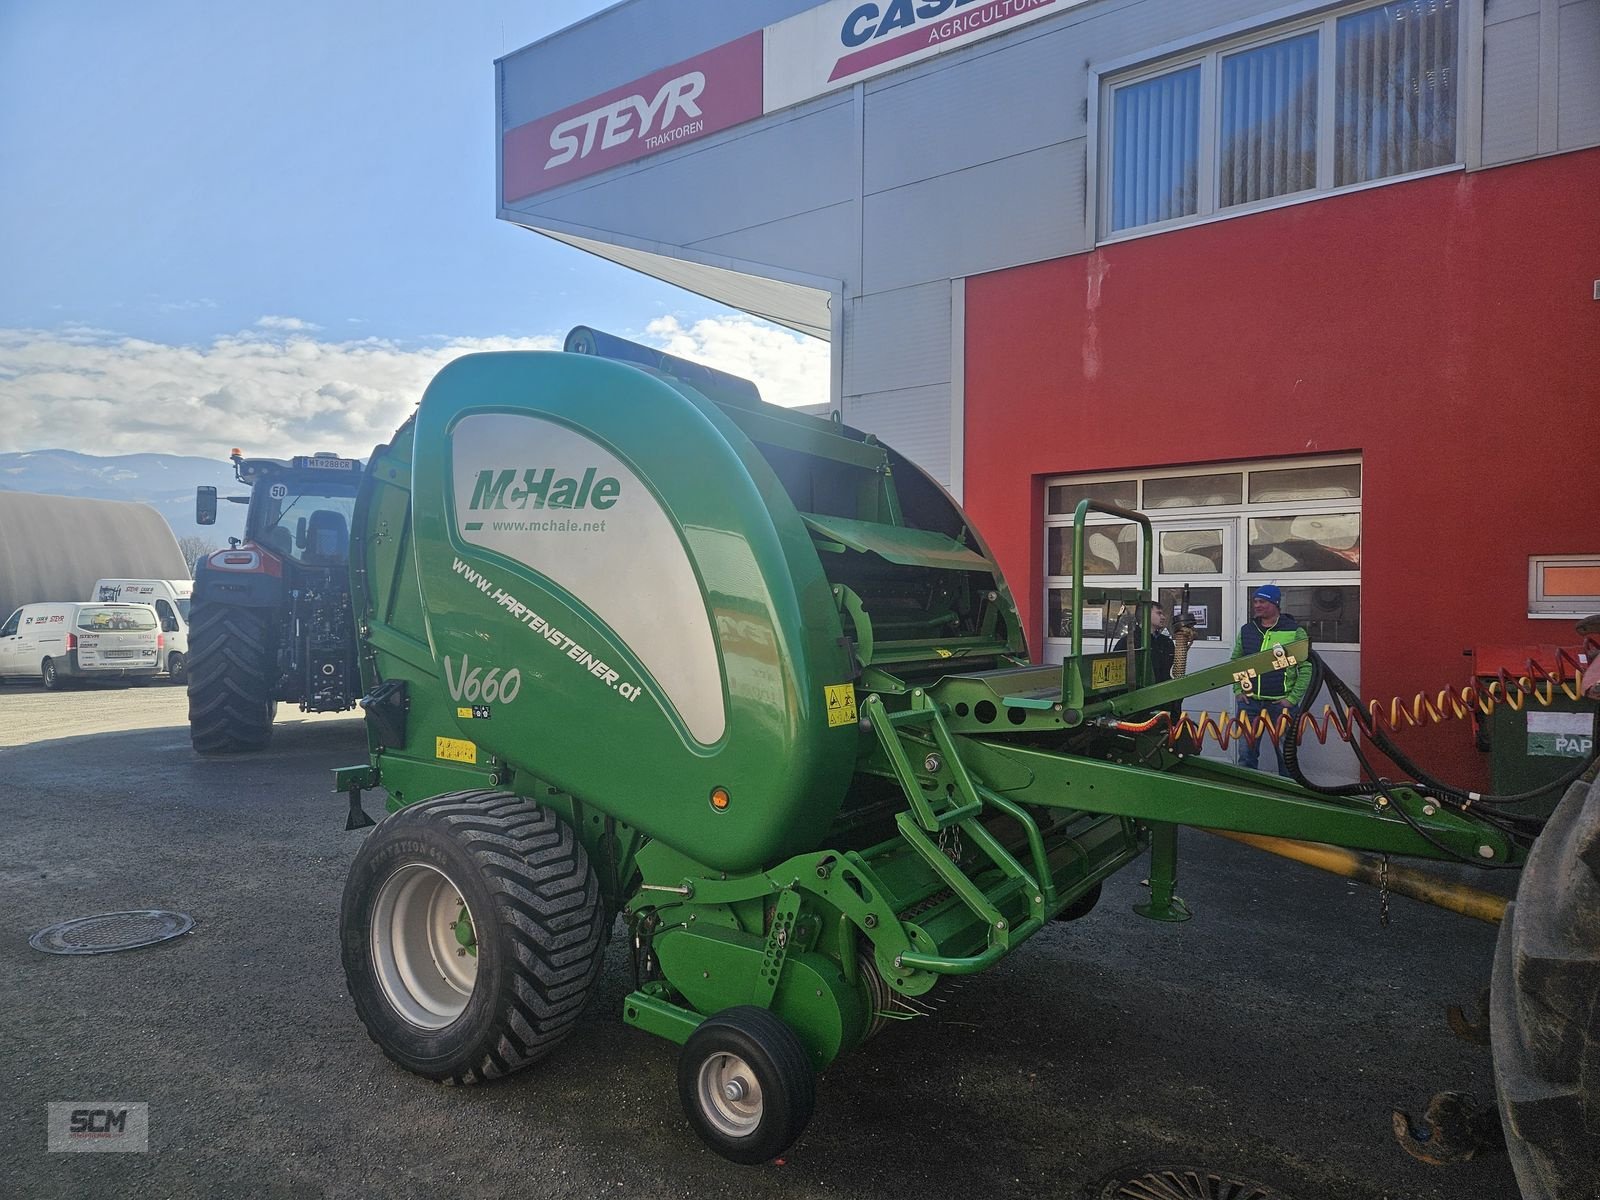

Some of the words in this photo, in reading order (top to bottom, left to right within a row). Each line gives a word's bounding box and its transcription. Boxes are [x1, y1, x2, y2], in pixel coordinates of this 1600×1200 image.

[544, 71, 706, 170] STEYR
[645, 120, 704, 150] TRAKTOREN
[272, 486, 286, 497] 50
[469, 467, 621, 510] McHale
[492, 519, 606, 532] www.mchale.net
[444, 654, 521, 704] V660
